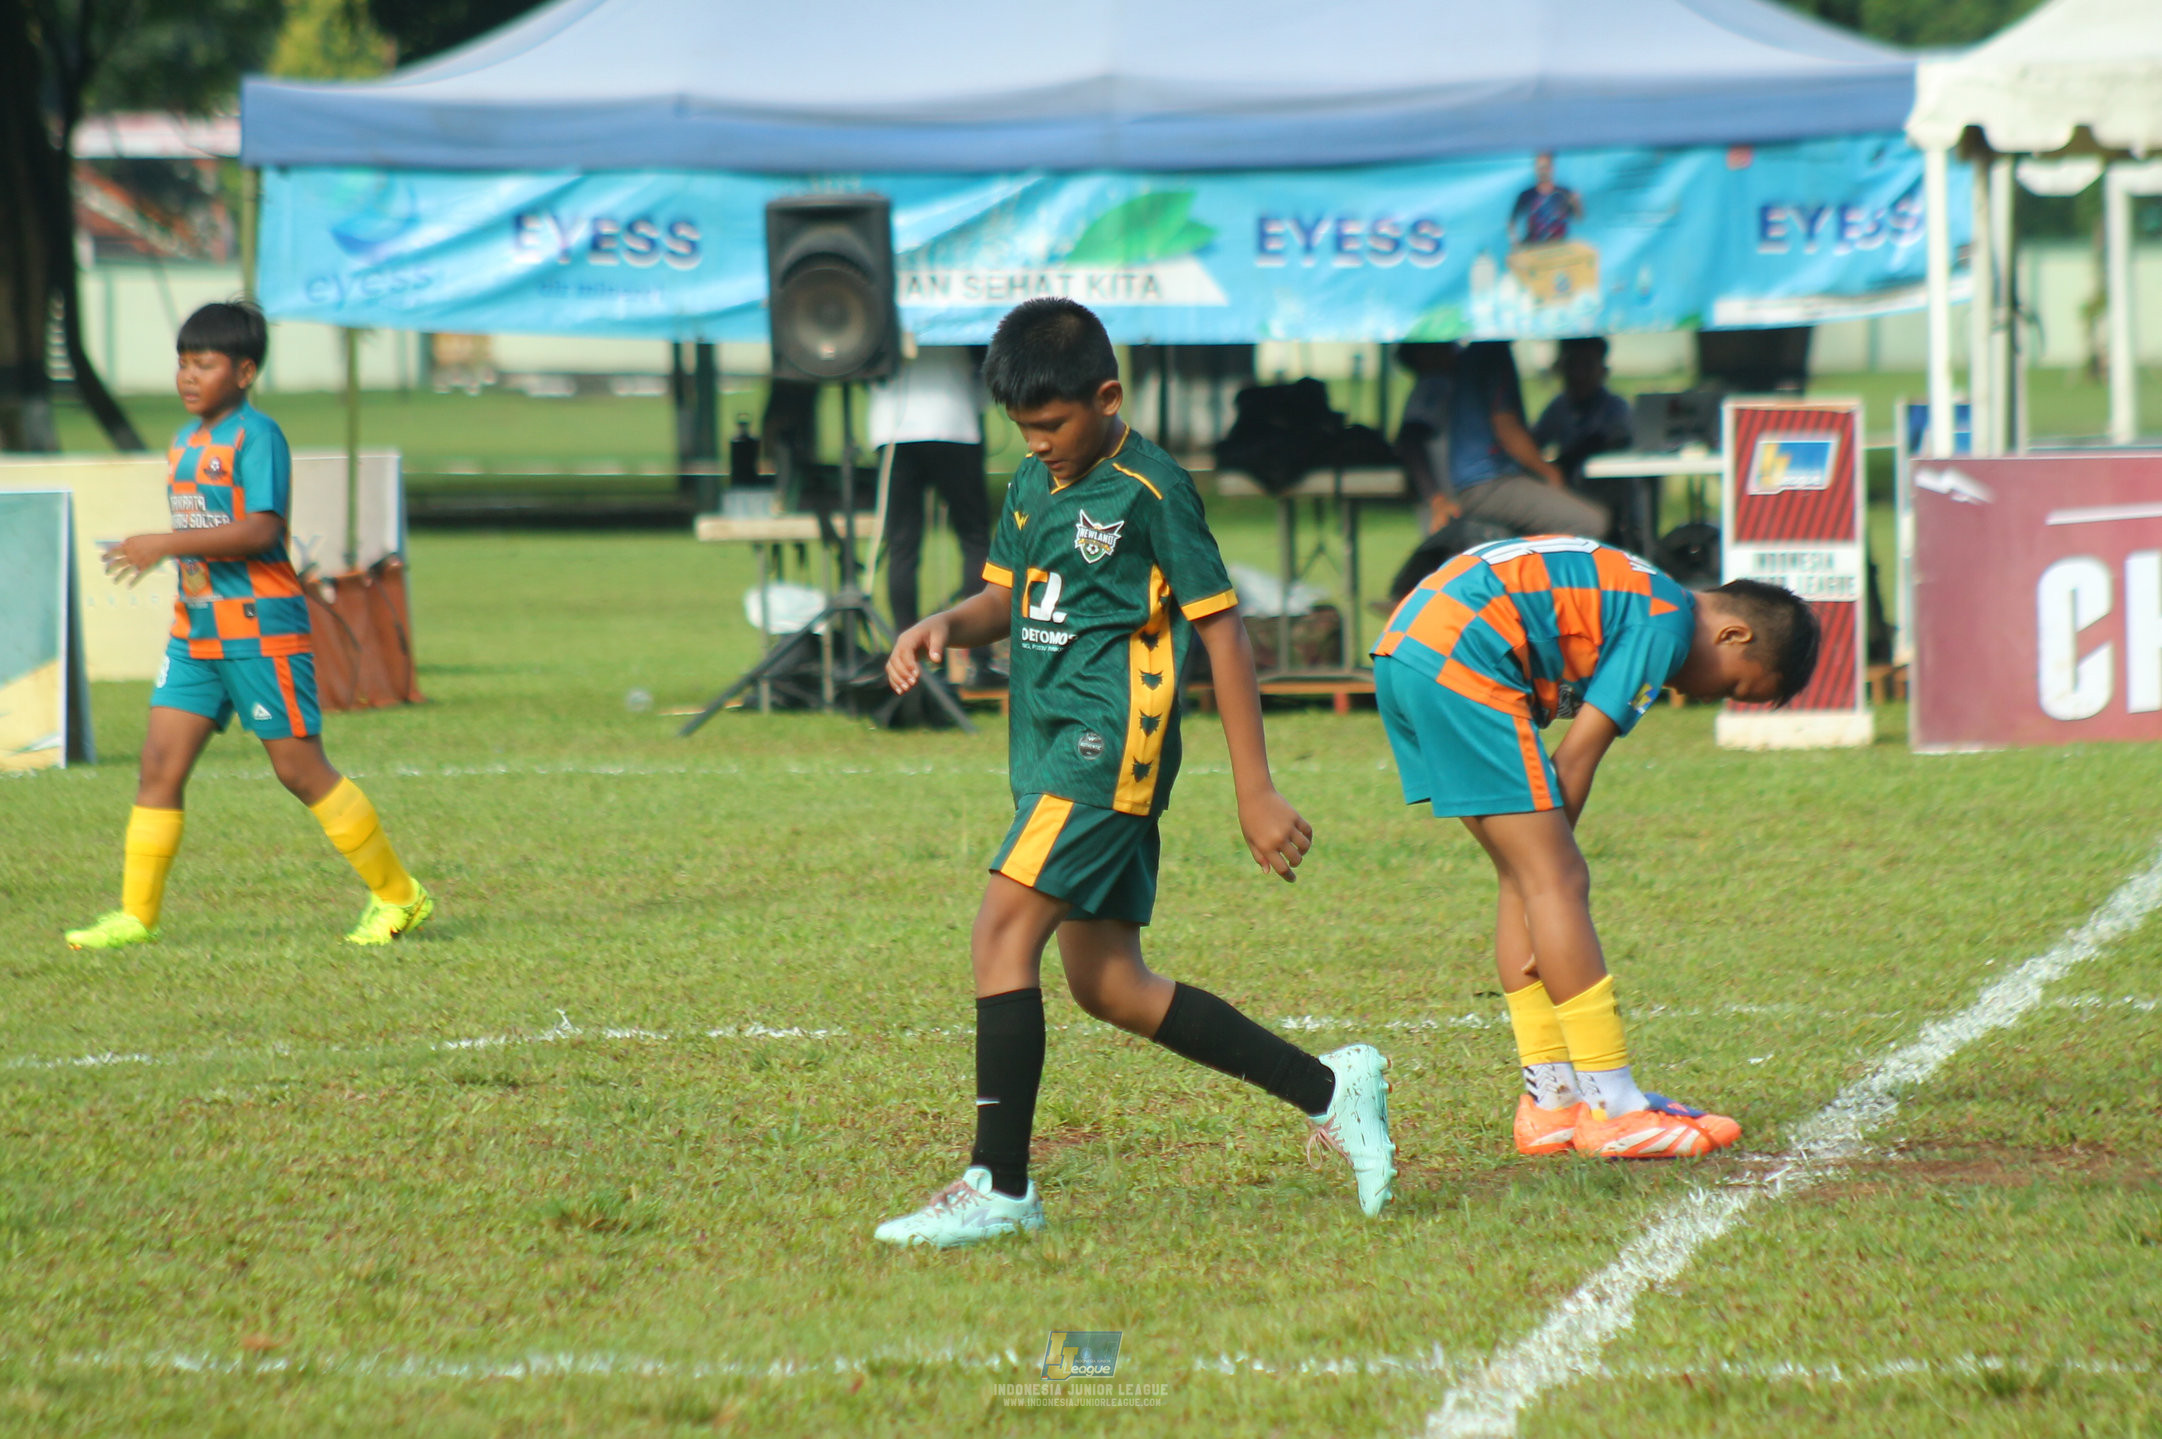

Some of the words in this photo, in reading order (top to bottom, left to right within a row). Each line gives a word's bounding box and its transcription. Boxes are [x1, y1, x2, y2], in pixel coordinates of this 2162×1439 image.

[511, 211, 702, 270] EYESS
[1254, 213, 1447, 269] EYESS
[1757, 198, 1926, 256] EYESS
[963, 272, 1075, 300] SEHAT
[1088, 274, 1163, 300] KITA
